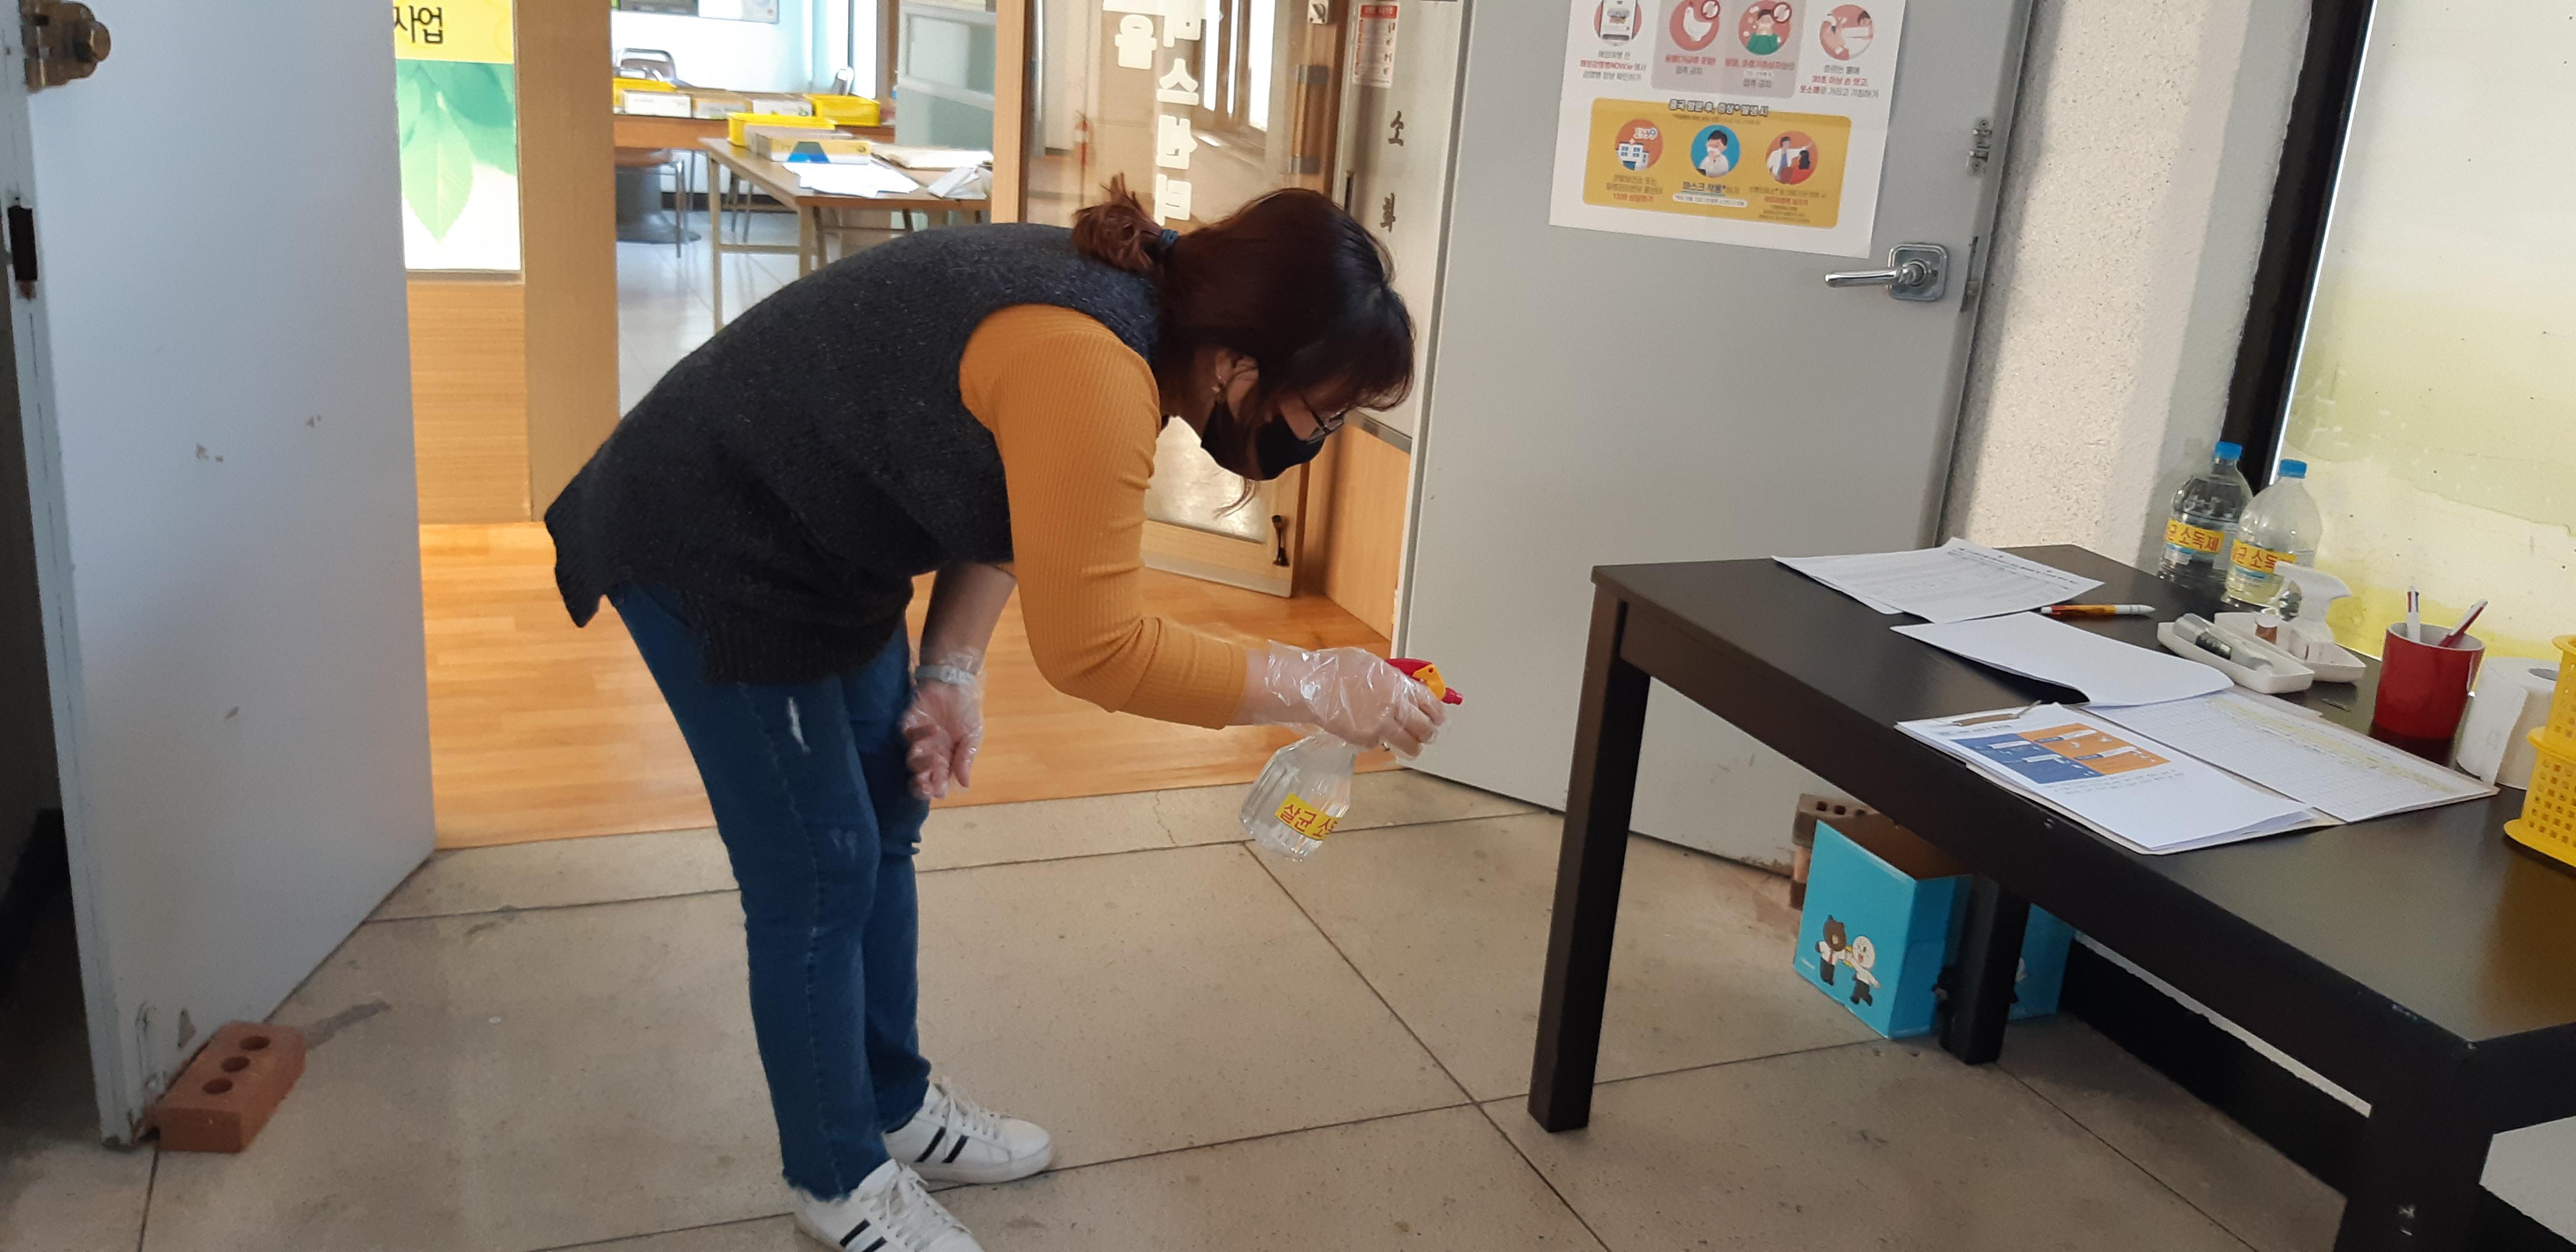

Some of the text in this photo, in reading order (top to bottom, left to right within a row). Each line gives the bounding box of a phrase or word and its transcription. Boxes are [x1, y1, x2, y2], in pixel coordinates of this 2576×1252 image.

[2179, 527, 2219, 552] 소독제
[2250, 550, 2293, 569] 소독
[1280, 804, 1318, 832] 살균
